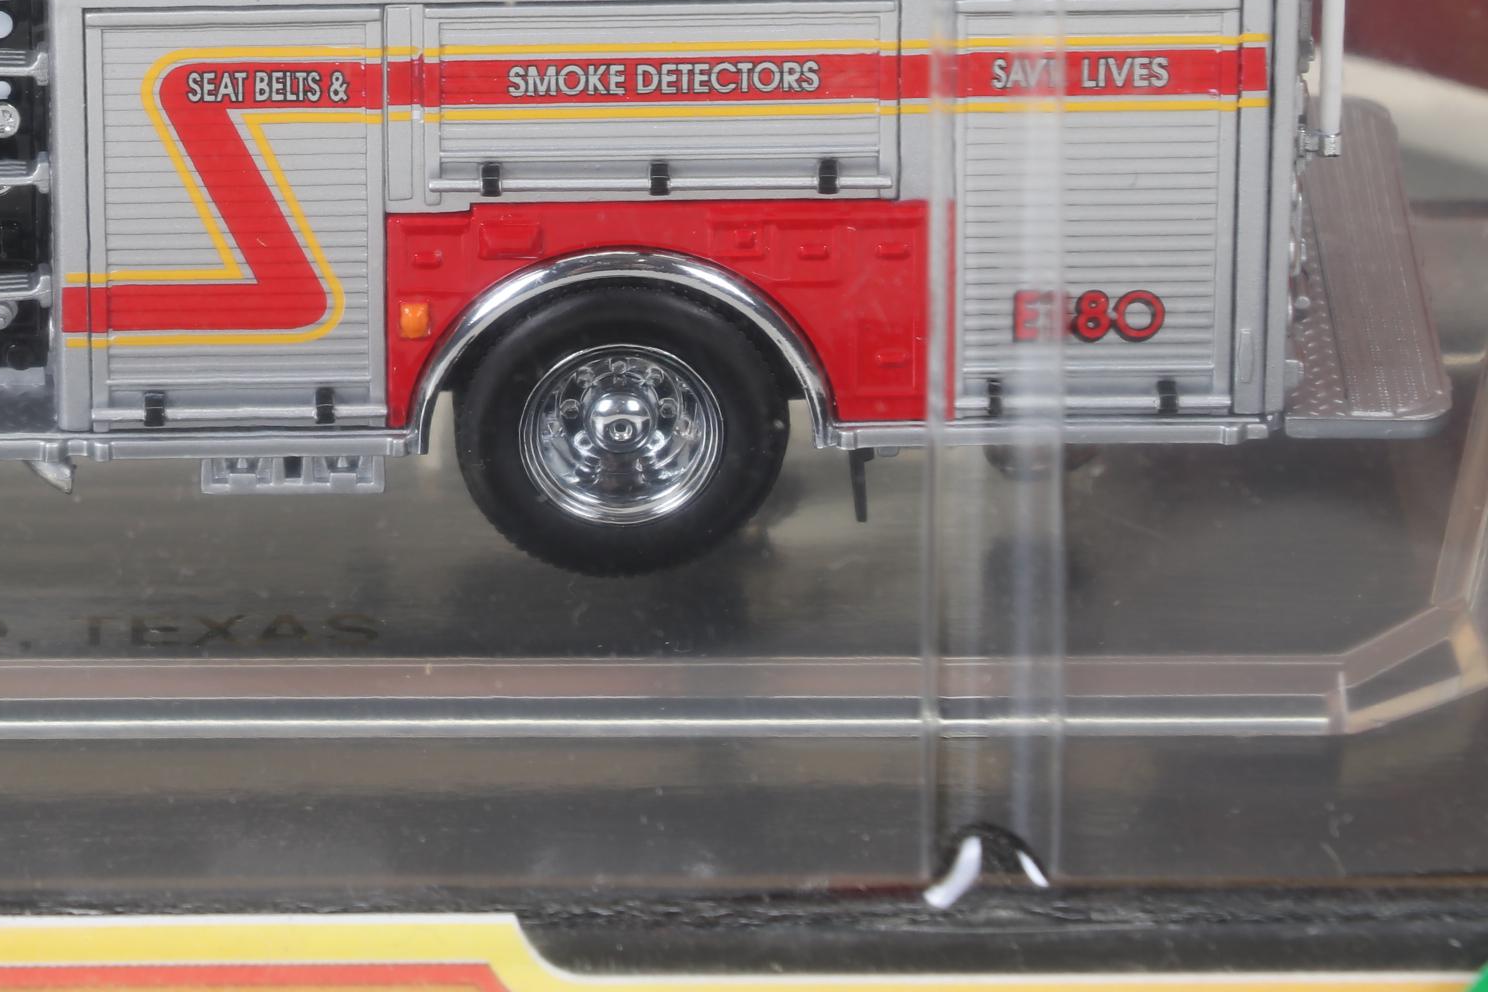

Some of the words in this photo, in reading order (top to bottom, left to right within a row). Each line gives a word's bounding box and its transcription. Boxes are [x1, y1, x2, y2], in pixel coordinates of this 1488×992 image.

[187, 71, 247, 103] SEAT
[253, 70, 321, 103] BELTS
[328, 70, 351, 102] &
[507, 62, 627, 98] SMOKE
[635, 59, 822, 95] DETECTORS
[1081, 56, 1170, 89] LIVES
[69, 612, 380, 650] TEXAS
